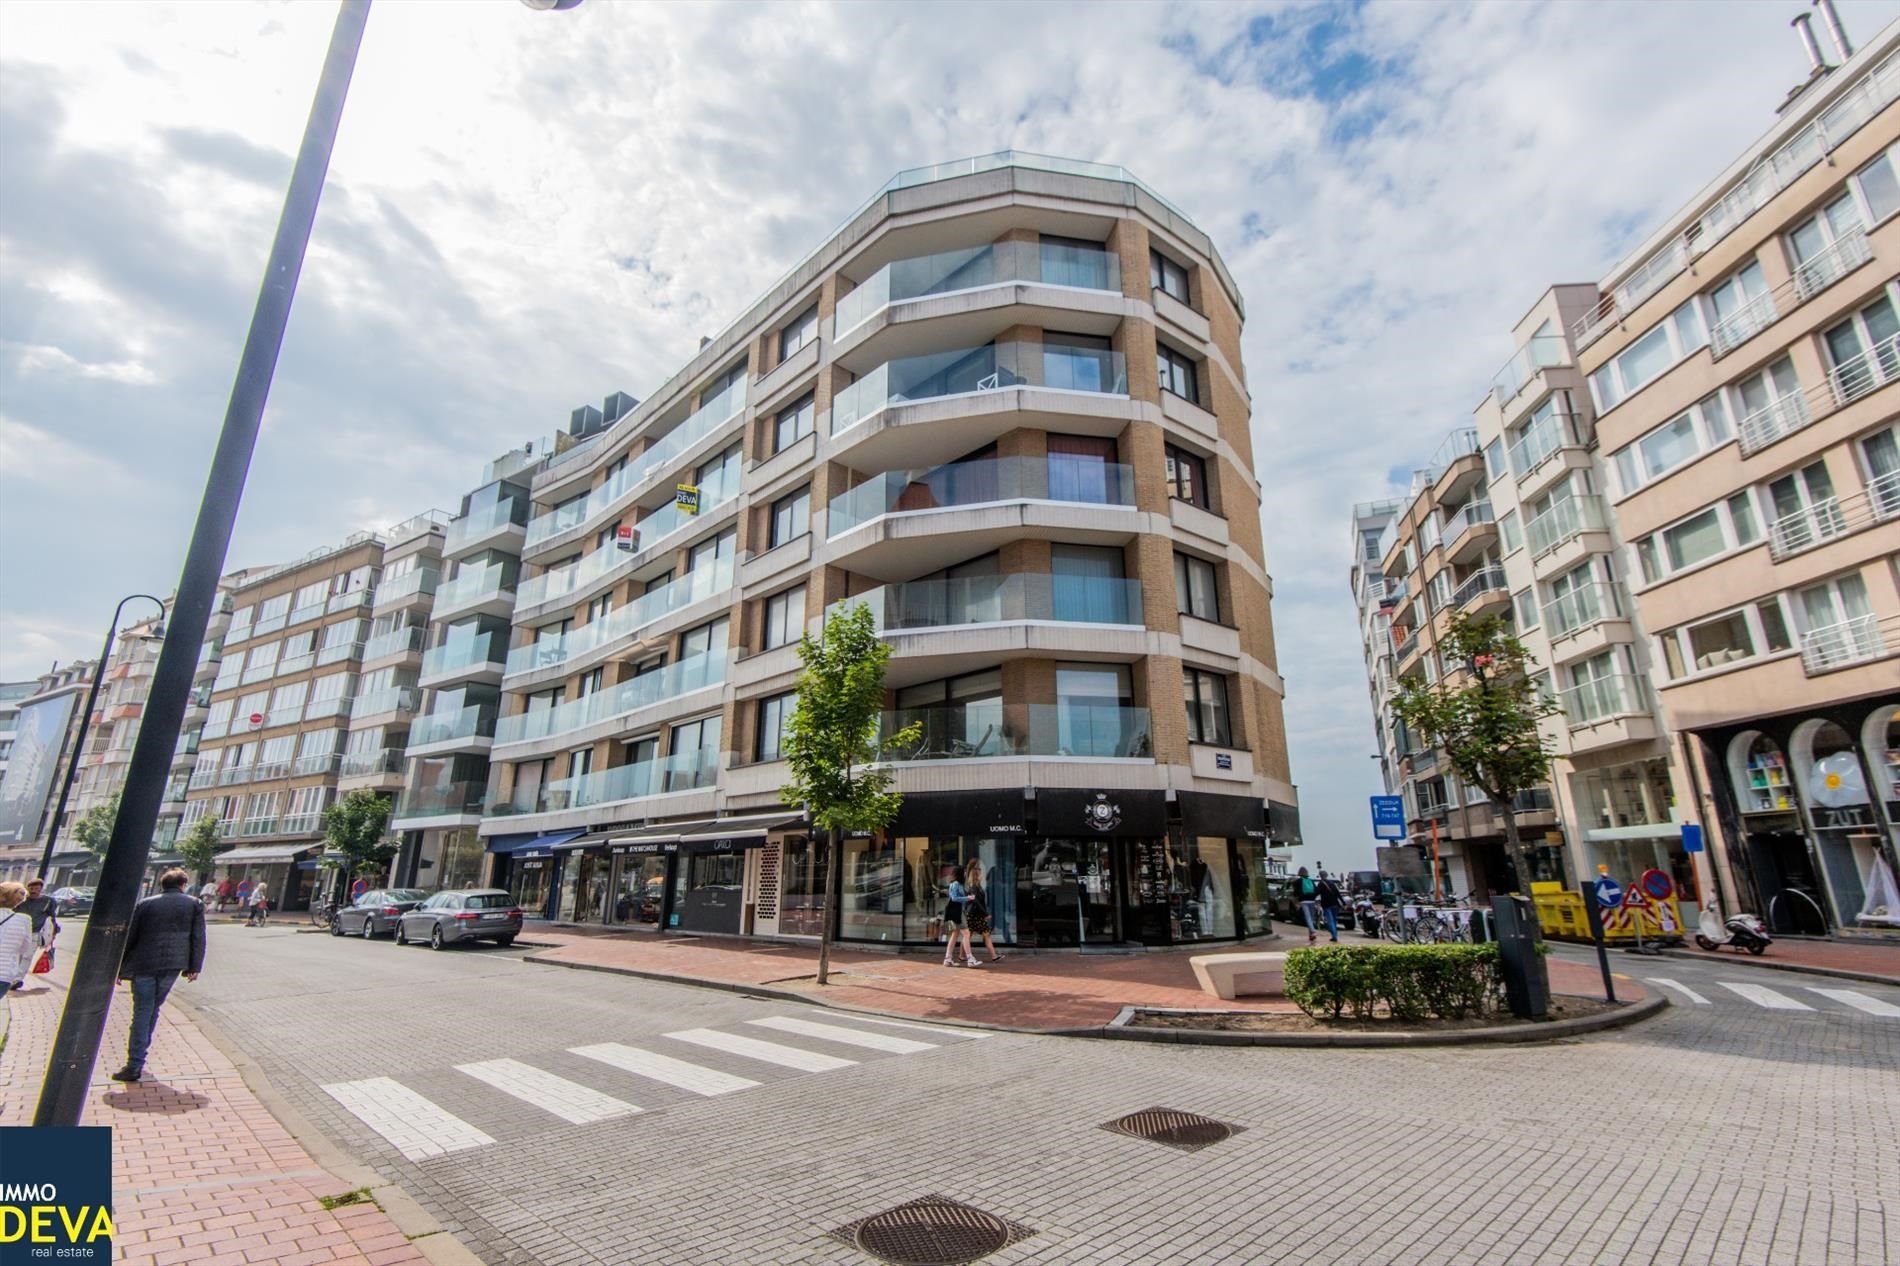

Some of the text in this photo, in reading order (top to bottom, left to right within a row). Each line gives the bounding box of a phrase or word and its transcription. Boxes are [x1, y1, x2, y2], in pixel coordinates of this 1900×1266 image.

[677, 495, 696, 505] DEVA
[1824, 809, 1863, 827] ZUT
[990, 825, 1009, 833] UOMO
